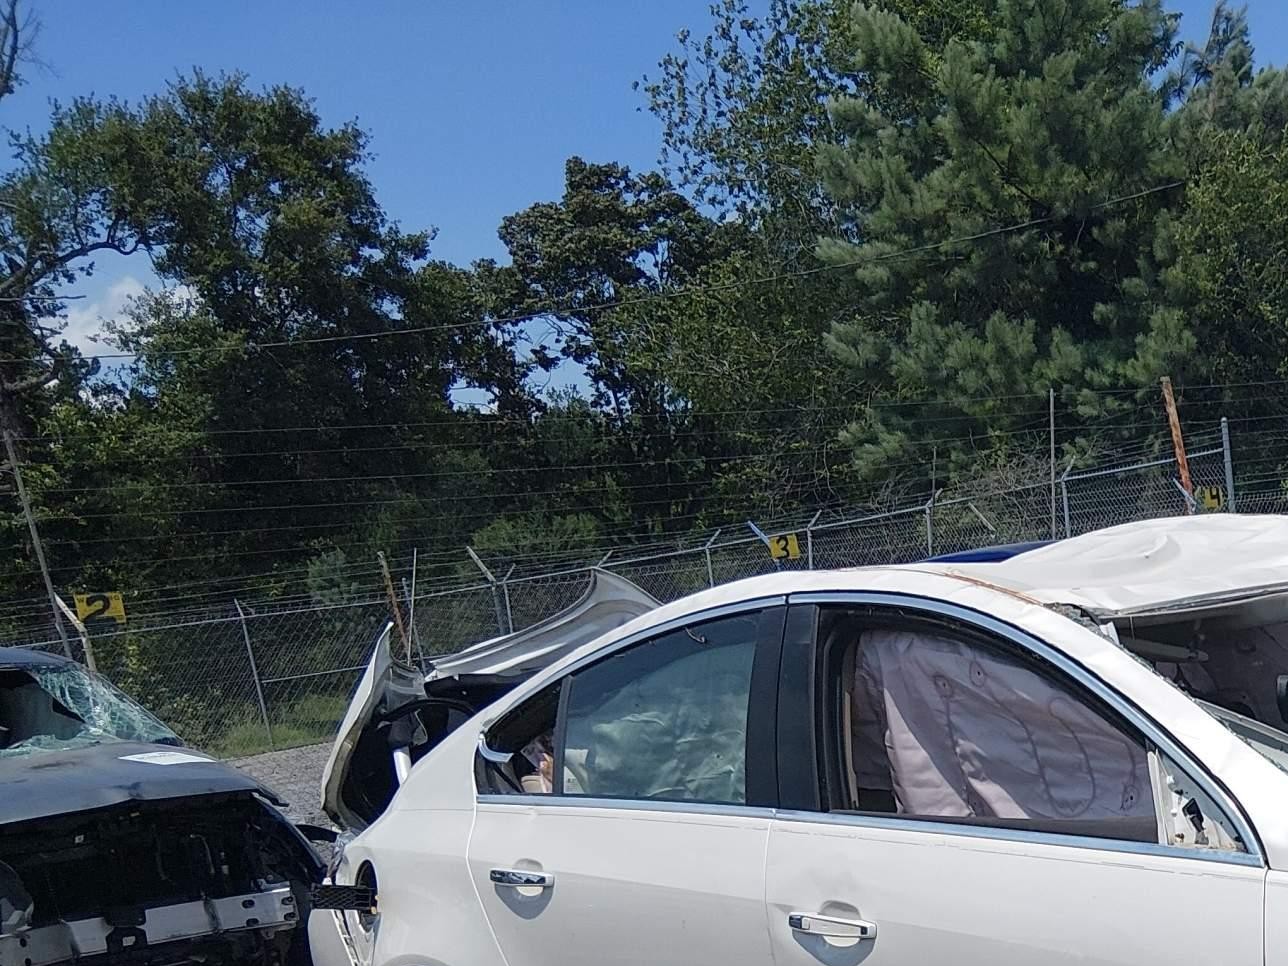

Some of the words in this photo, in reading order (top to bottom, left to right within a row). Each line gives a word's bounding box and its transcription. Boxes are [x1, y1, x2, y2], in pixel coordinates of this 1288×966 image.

[1210, 487, 1221, 506] 4
[776, 536, 790, 559] 3
[83, 594, 117, 622] 2
